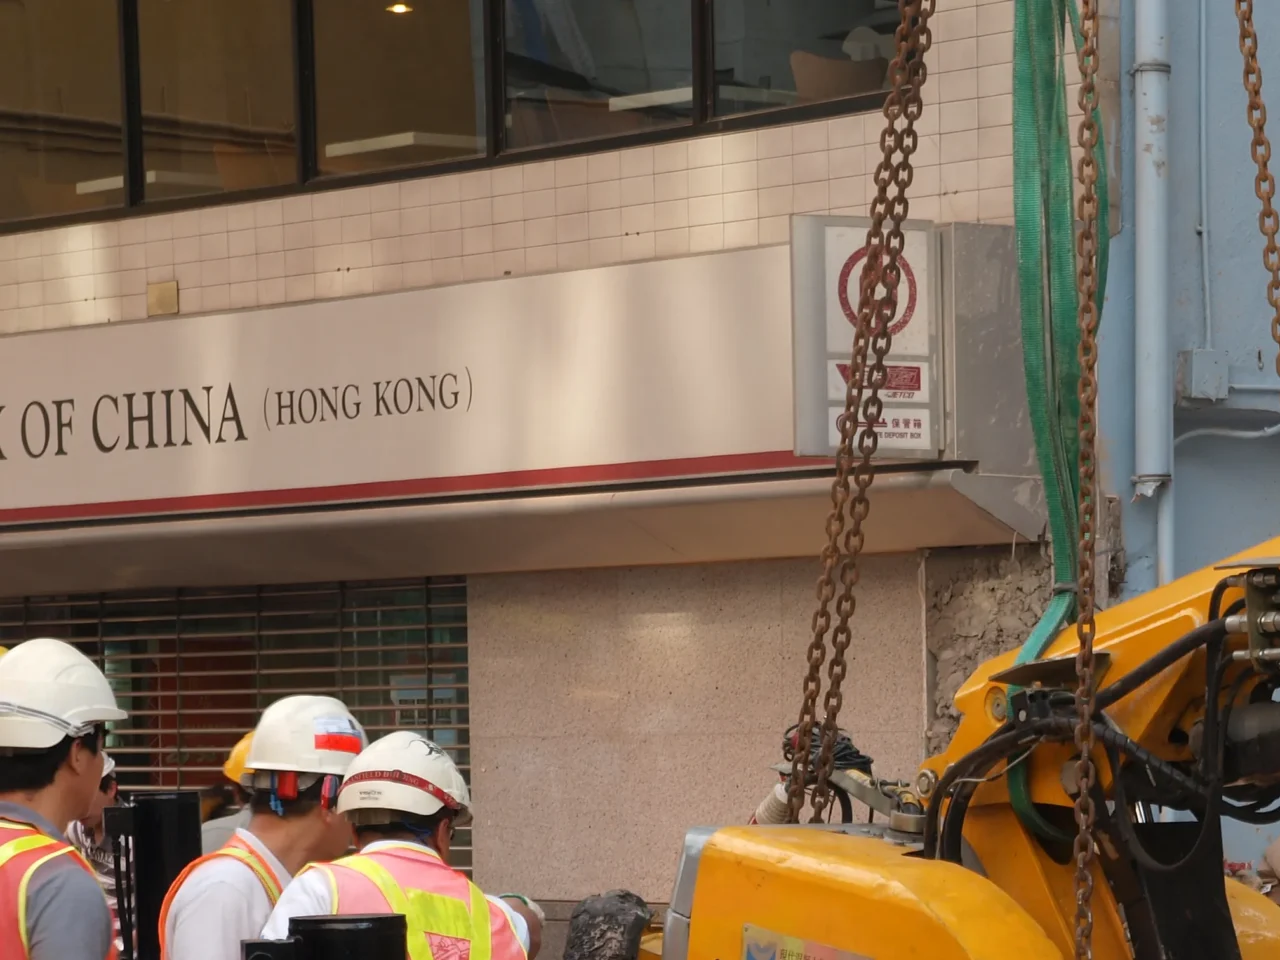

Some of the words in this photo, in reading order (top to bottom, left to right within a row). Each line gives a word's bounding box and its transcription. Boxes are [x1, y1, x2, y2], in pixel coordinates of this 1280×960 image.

[20, 398, 75, 459] OF
[91, 382, 248, 454] CHINA
[262, 383, 362, 431] (HONG
[373, 366, 473, 418] KONG)
[891, 418, 922, 429] 保管箱
[884, 431, 909, 439] DEPOSIT
[910, 432, 922, 440] BOX
